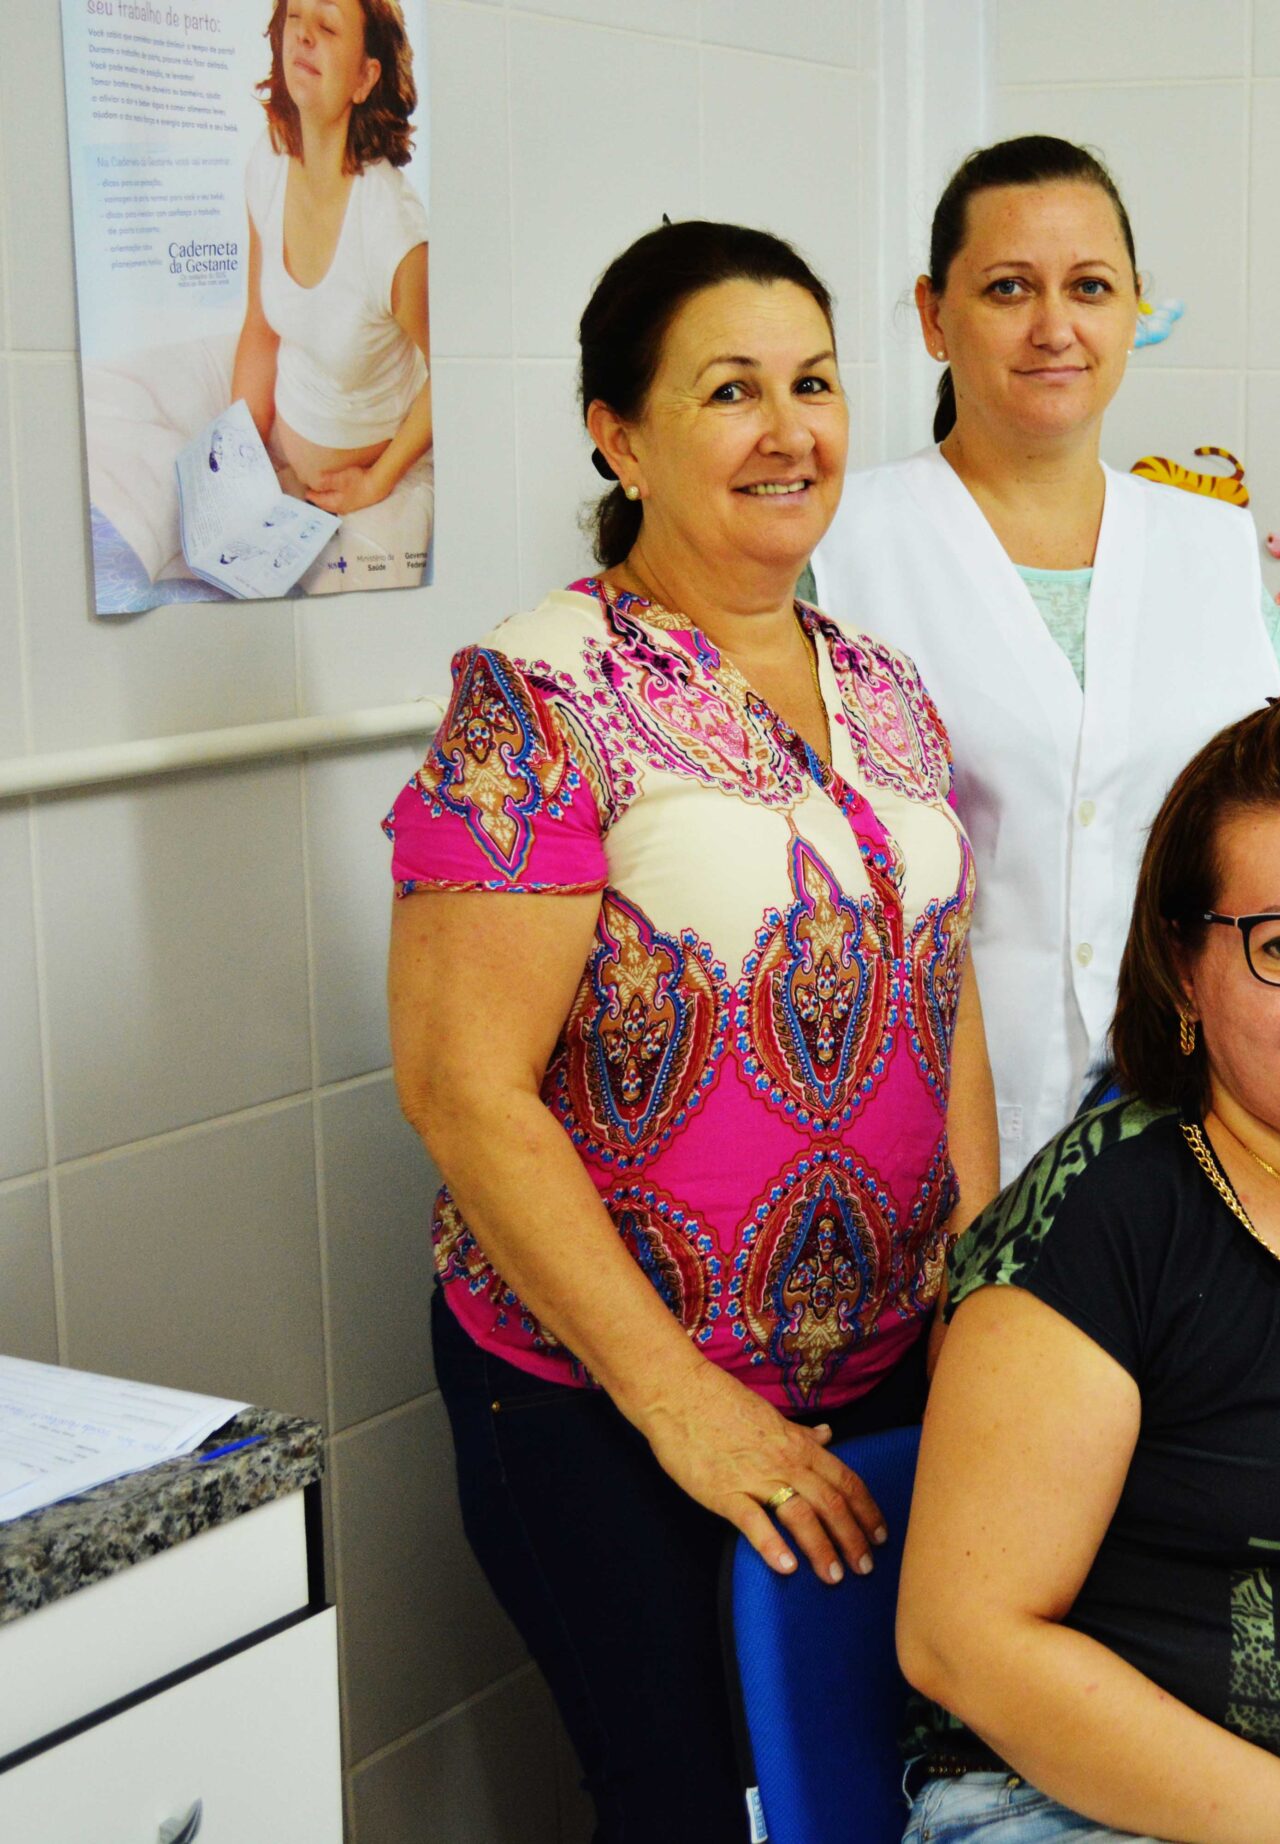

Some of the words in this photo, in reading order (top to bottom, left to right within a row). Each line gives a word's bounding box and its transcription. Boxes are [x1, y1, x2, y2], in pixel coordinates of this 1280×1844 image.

[118, 0, 162, 25] trabalho
[166, 6, 179, 28] de
[184, 13, 222, 35] parto:
[168, 240, 238, 258] Caderneta
[169, 258, 181, 273] da
[185, 257, 238, 273] Gestante
